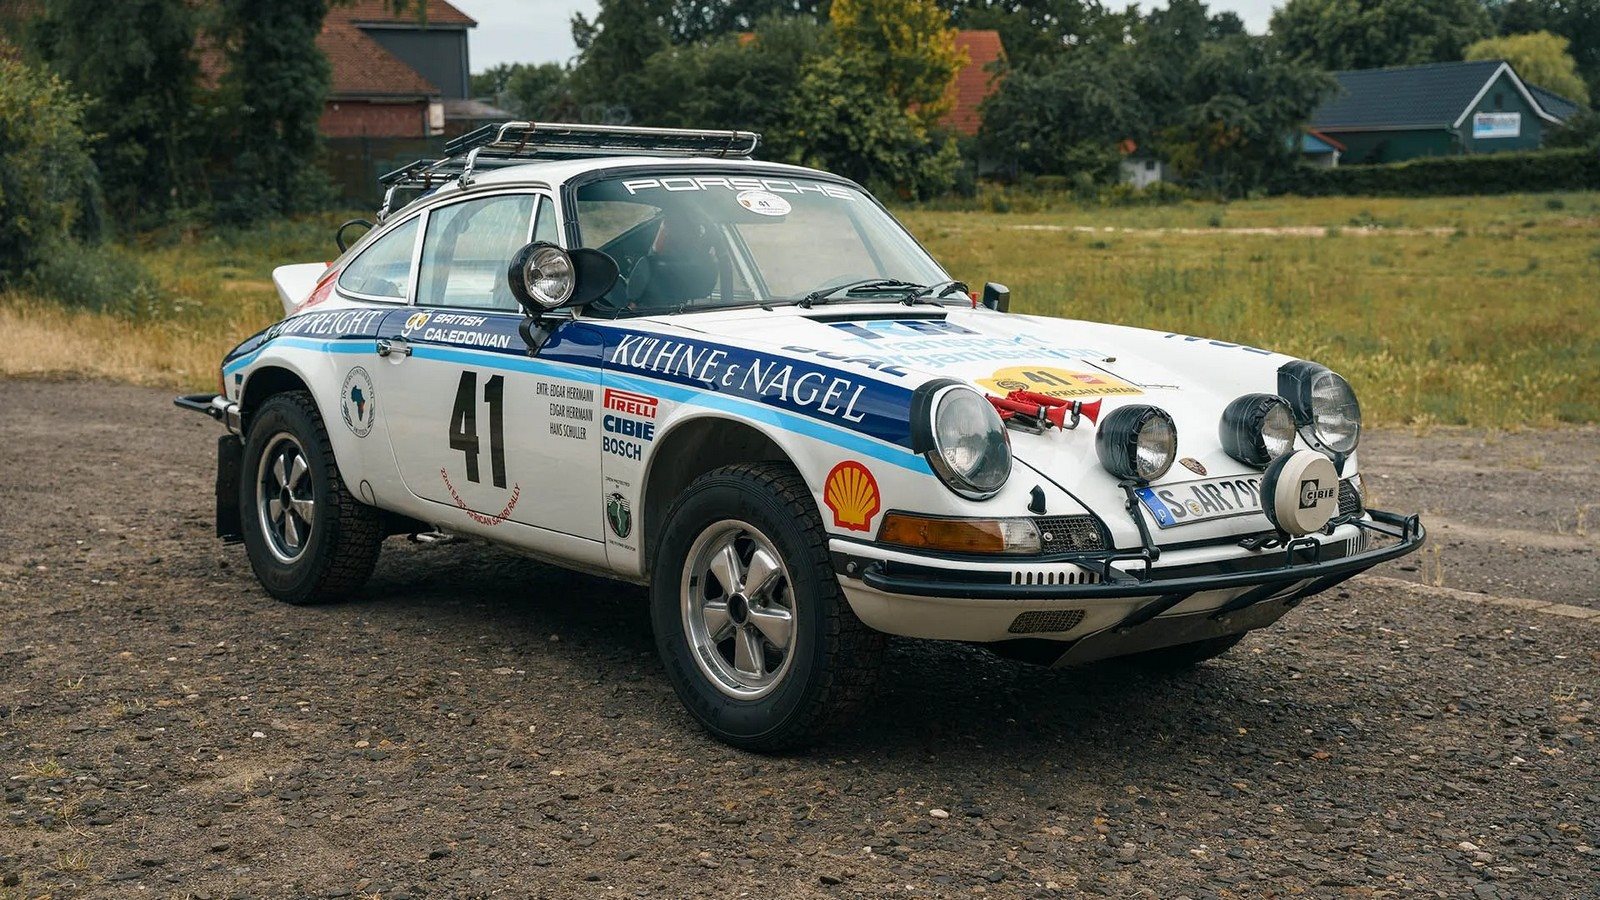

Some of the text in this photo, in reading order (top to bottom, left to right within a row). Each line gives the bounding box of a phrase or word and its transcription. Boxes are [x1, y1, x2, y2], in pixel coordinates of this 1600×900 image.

[622, 177, 854, 200] PORSCHE
[758, 200, 770, 208] 41
[432, 313, 487, 328] BRITISH
[424, 328, 511, 349] CALEDONIAN
[610, 334, 727, 383] KÜHNE
[739, 358, 867, 424] NAGEL
[1022, 370, 1073, 388] 41
[550, 384, 565, 398] EDGAR
[566, 386, 594, 402] HERRMANN
[603, 388, 659, 419] PIRELLI
[549, 403, 593, 422] EDGAR HERRMANN
[449, 370, 507, 489] 41
[549, 422, 562, 437] HANS
[602, 435, 642, 462] BOSCH
[440, 467, 453, 491] 22nd
[508, 483, 521, 511] RALLY
[1158, 489, 1187, 518] S
